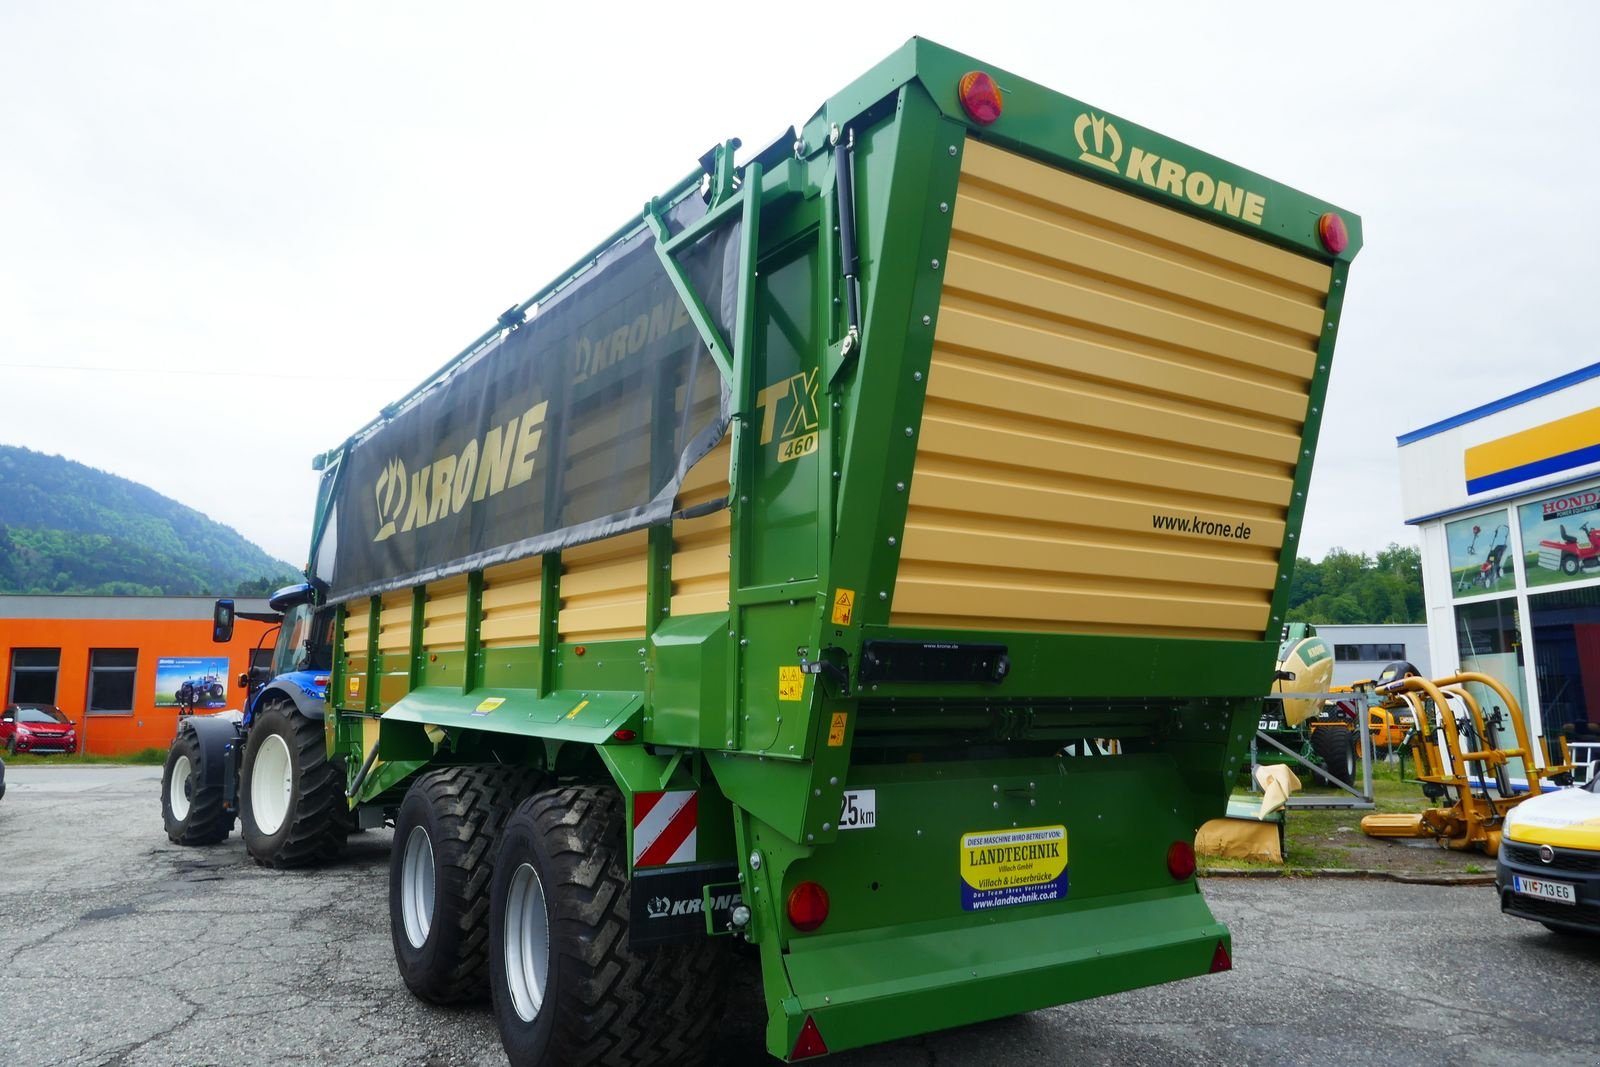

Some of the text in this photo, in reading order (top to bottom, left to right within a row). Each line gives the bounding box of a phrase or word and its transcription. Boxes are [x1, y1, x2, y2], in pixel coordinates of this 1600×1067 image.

[1125, 146, 1266, 225] KRONE
[756, 366, 819, 446] TX
[784, 436, 814, 457] 460
[401, 400, 548, 532] KRONE
[1543, 493, 1600, 514] HOND
[1152, 514, 1251, 540] www.krone.de
[838, 794, 874, 826] 25 km
[967, 838, 983, 847] DIESE
[983, 835, 1011, 845] MASCHINE
[1011, 833, 1025, 842] WIRD
[1026, 831, 1048, 841] BETREUT
[969, 842, 1060, 867] LANDTECHNIK
[998, 862, 1033, 873] Villach GmbH
[978, 871, 1052, 888] Villach & Lieserbrücke
[972, 890, 1058, 910] www.landtechnik.co.at
[973, 891, 984, 899] Das
[987, 889, 1003, 897] Team
